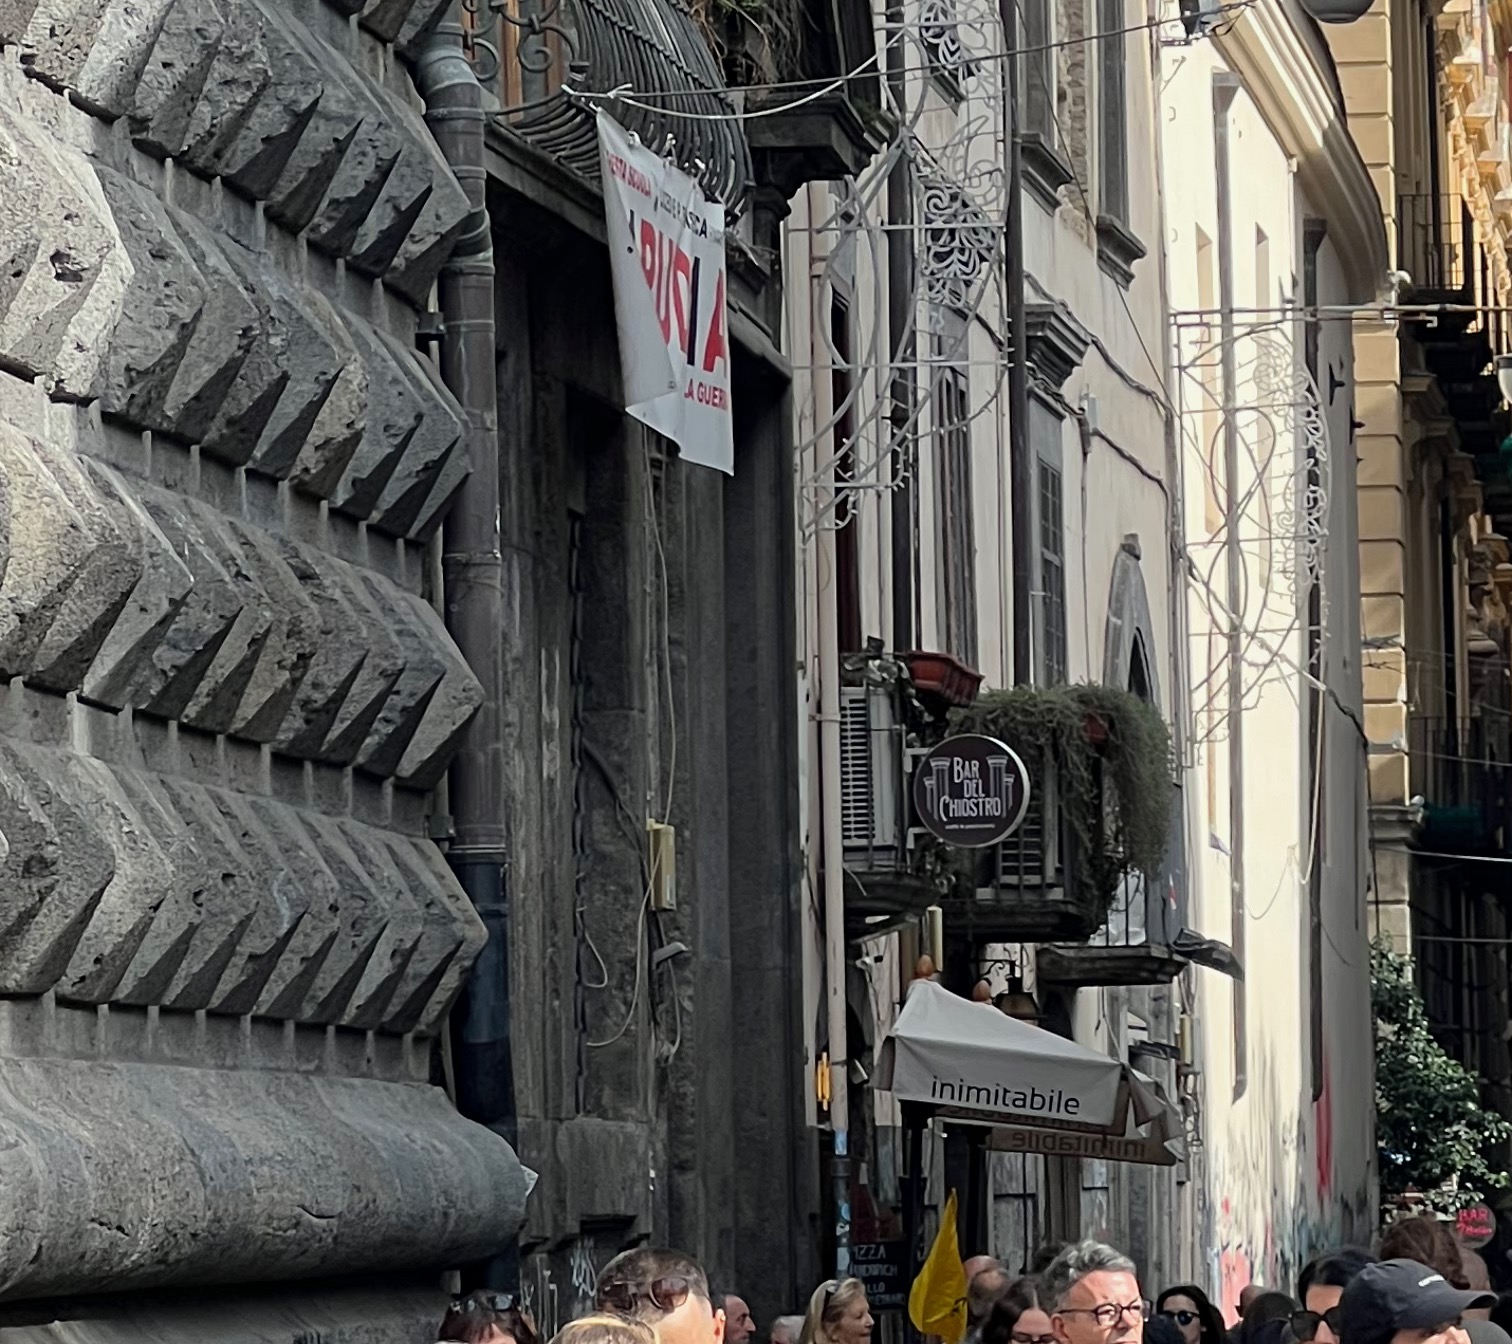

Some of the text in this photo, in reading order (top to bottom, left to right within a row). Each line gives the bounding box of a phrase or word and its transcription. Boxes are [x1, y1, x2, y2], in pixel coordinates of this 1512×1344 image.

[952, 756, 980, 783] BAR
[963, 778, 986, 798] DEL
[939, 795, 1002, 822] CHIOSTRO
[930, 1074, 1081, 1116] inimitabile
[853, 1243, 887, 1261] IZZA
